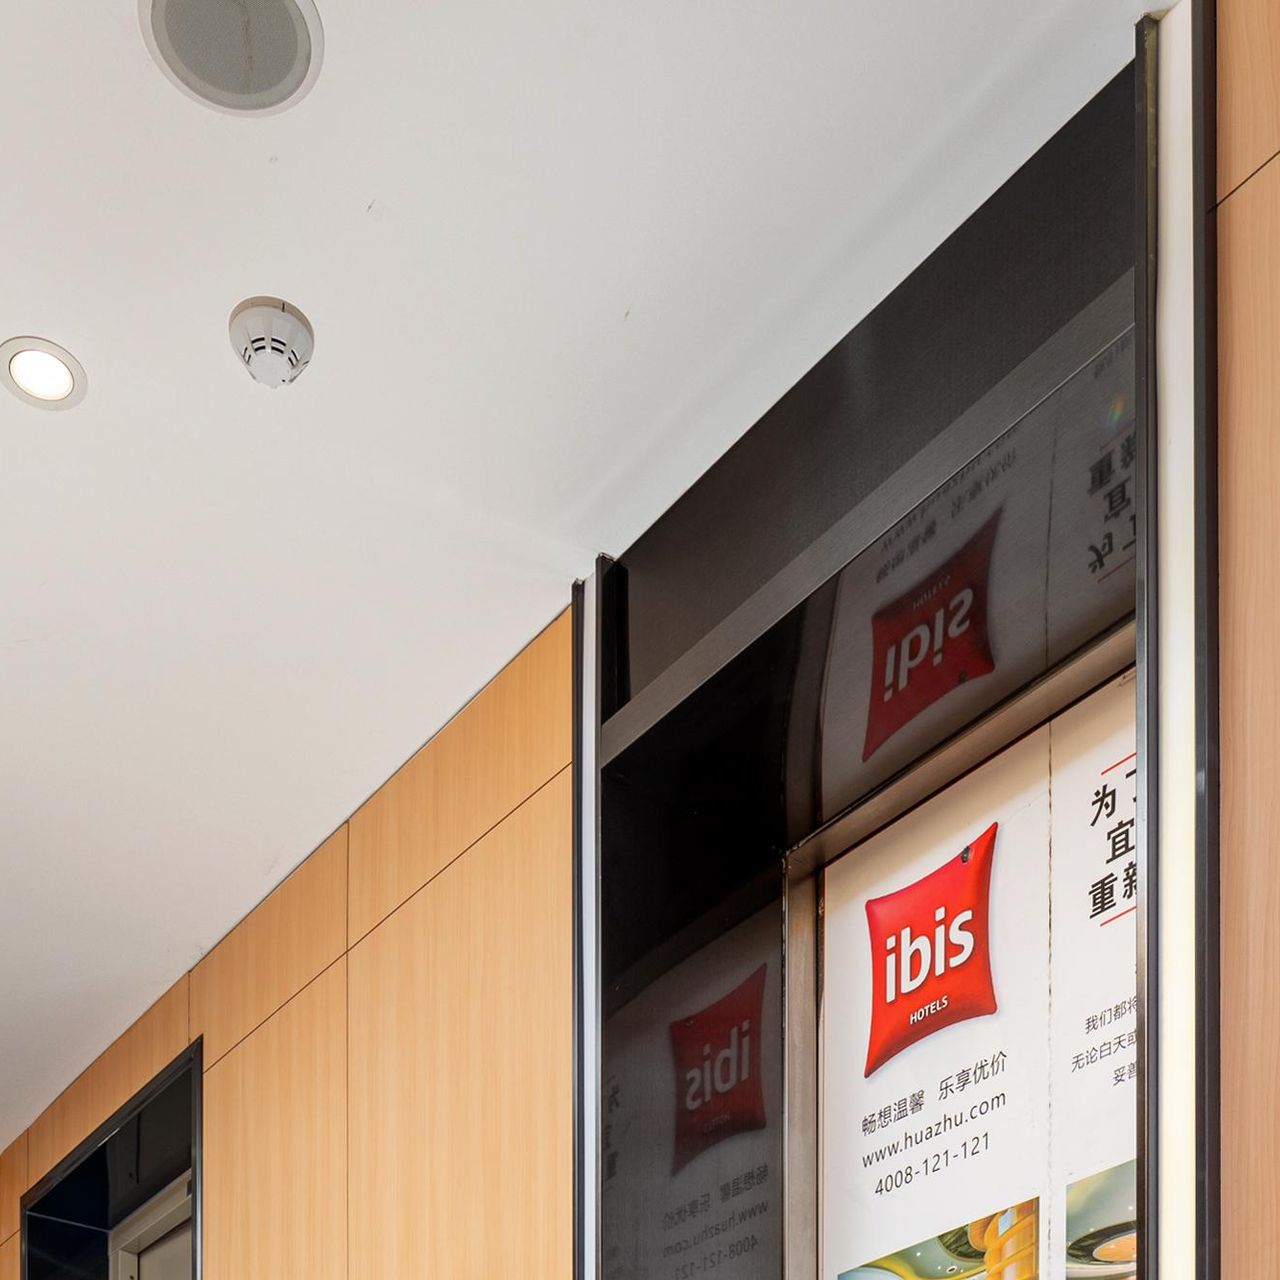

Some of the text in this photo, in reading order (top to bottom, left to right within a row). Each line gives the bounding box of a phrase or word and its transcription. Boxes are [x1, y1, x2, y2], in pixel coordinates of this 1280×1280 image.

[885, 905, 975, 1004] ibis
[909, 995, 948, 1025] HOTELS
[861, 1050, 1008, 1137] 畅想温馨 乐享优价
[861, 1092, 1007, 1168] www.huazhu.com
[874, 1131, 990, 1196] 4008-121-121
